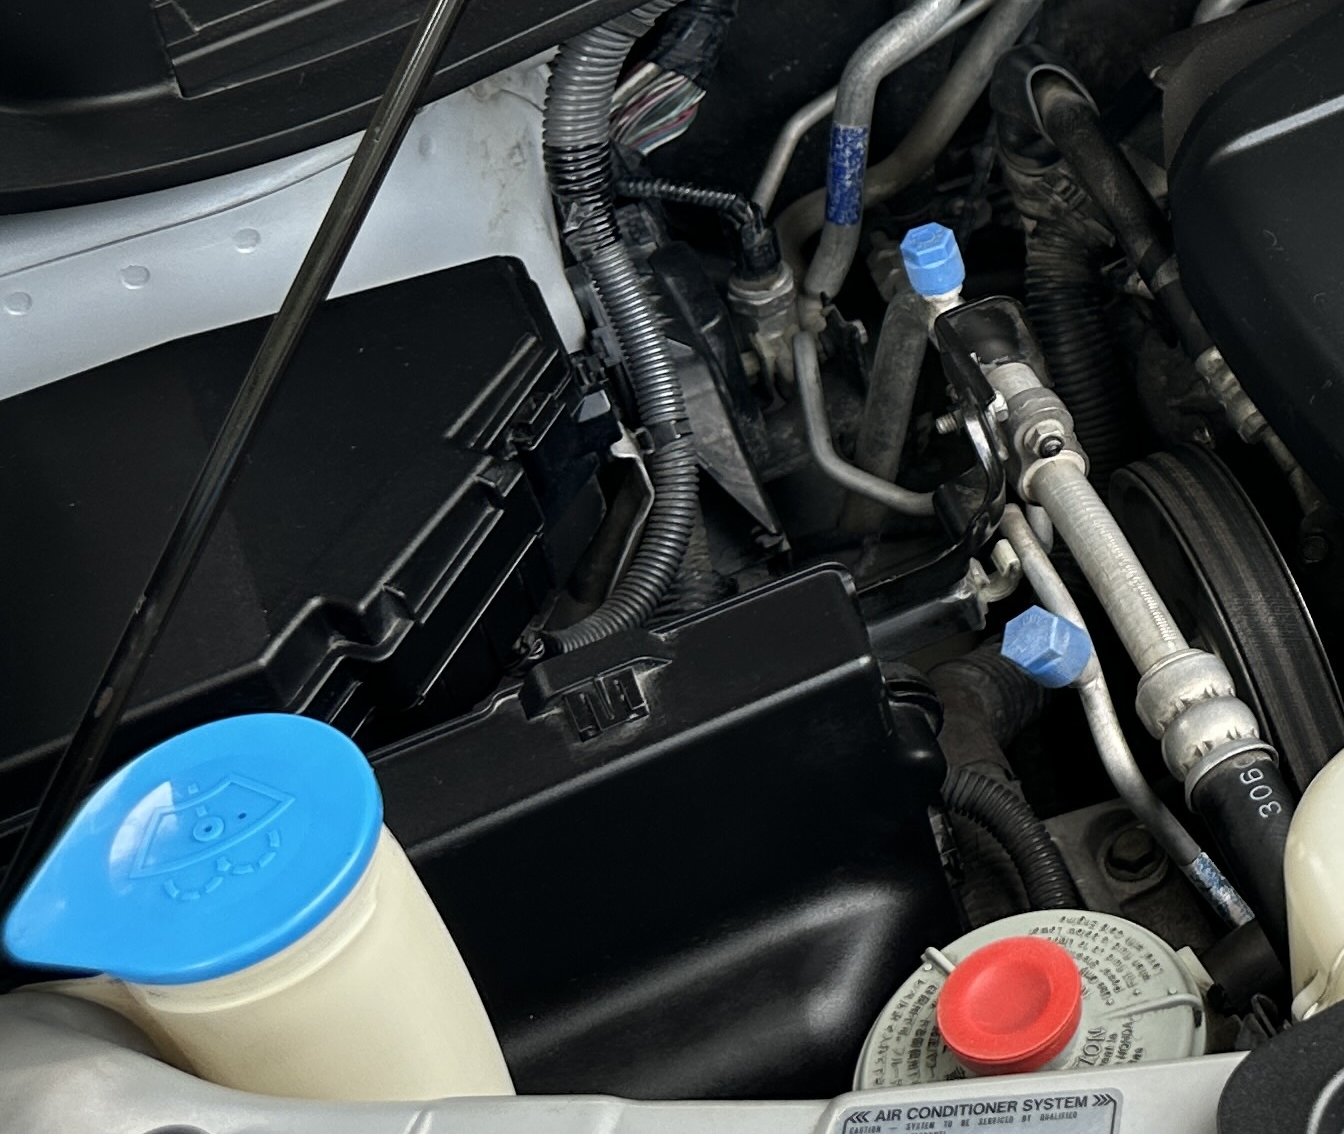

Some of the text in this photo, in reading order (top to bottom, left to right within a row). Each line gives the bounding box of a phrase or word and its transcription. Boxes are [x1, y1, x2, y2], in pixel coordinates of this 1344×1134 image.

[873, 1095, 1088, 1122] AIR CONDITIONER SYSTEM
[849, 1125, 882, 1134] CAUTION
